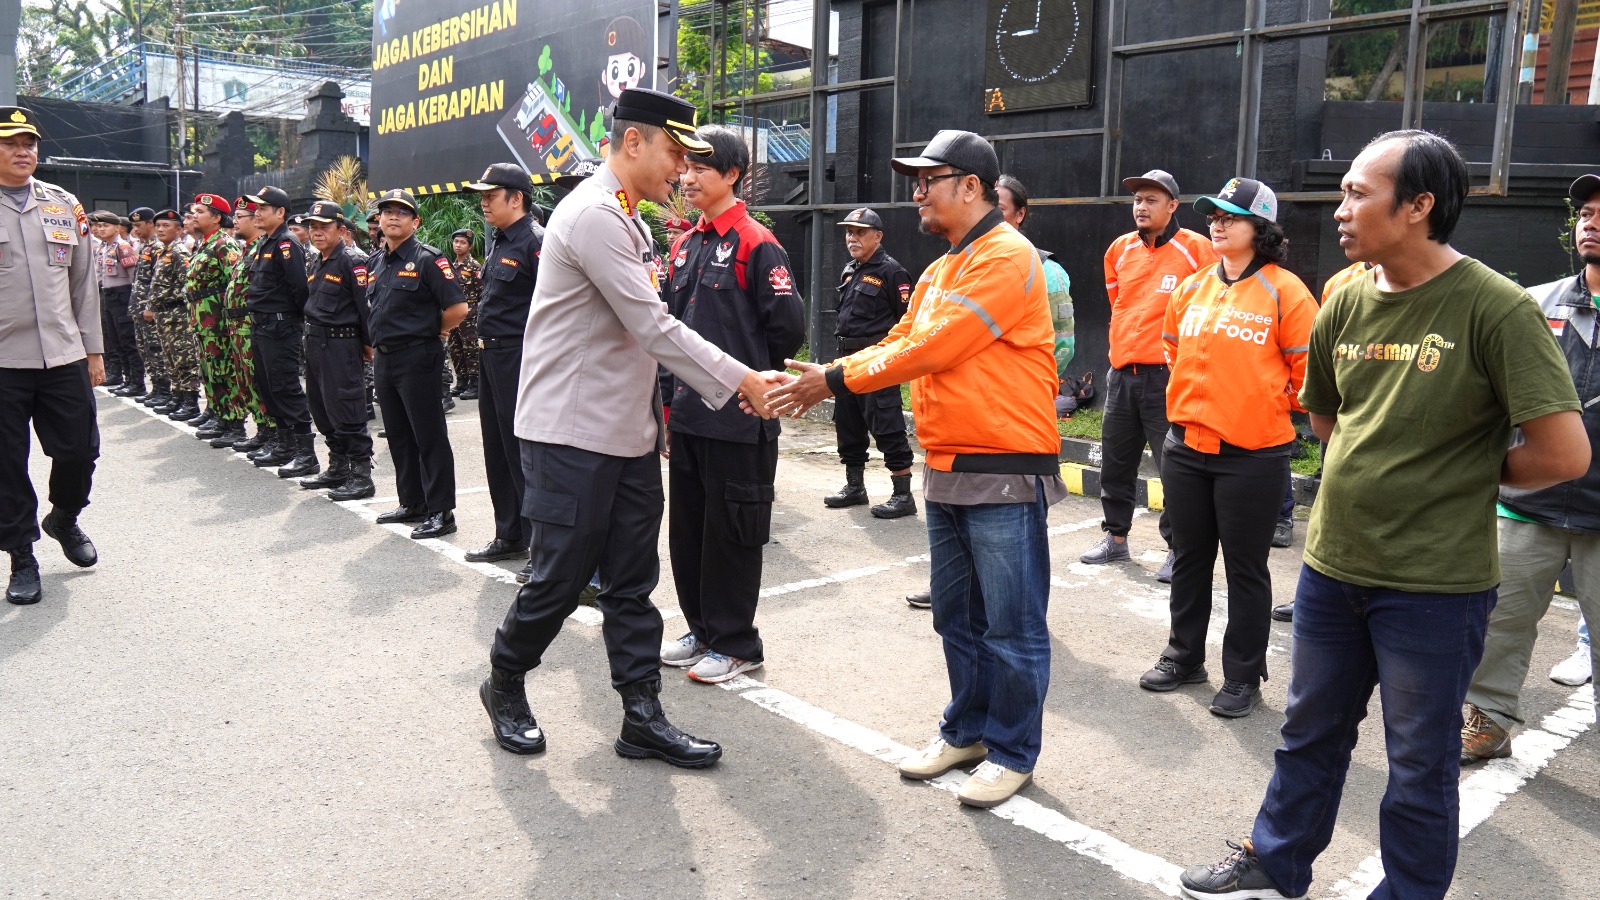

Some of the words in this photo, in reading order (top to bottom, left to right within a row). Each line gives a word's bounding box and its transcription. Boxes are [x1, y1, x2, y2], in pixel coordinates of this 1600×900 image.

[373, 35, 410, 71] JAGA
[412, 0, 517, 58] KEBERSIHAN
[418, 55, 453, 91] DAN
[377, 102, 416, 135] JAGA
[418, 79, 504, 127] KERAPIAN
[44, 217, 72, 228] POLRI
[1221, 304, 1272, 326] Shopee
[1213, 317, 1270, 346] Food
